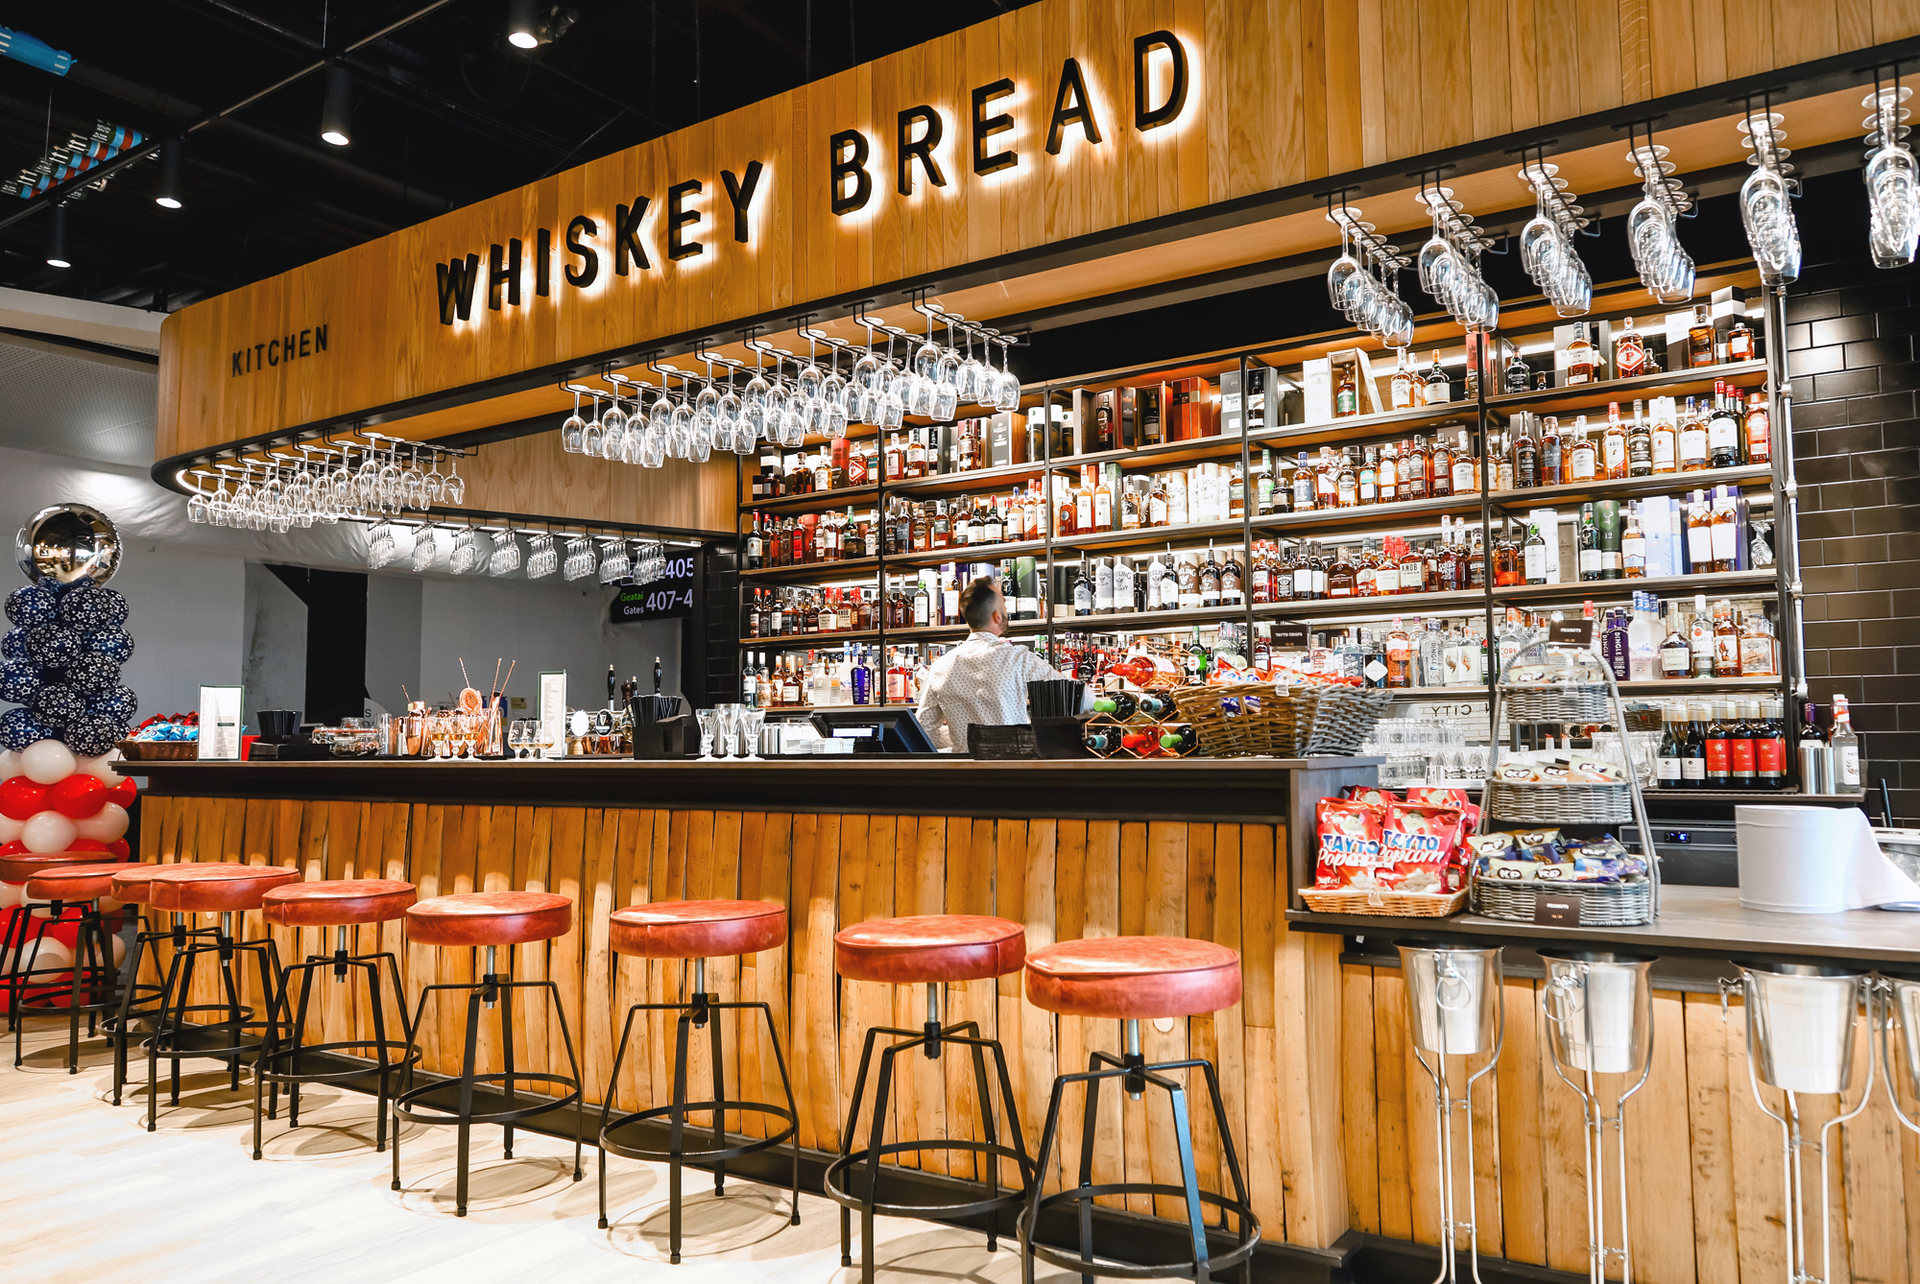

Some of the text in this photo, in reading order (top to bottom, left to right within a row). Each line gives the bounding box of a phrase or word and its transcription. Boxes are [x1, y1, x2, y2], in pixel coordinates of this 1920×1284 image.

[436, 30, 1189, 325] WHISKEY BREAD
[232, 324, 327, 377] KITCHEN
[1401, 563, 1418, 572] KNOB
[620, 591, 644, 602] Geataí
[623, 605, 645, 616] Gates
[1430, 642, 1438, 664] DINGLE
[1614, 632, 1622, 655] DINGLE
[1322, 834, 1380, 854] TAYTO
[1382, 829, 1440, 850] TAYTO
[1499, 868, 1522, 879] KP
[1537, 868, 1561, 879] KP
